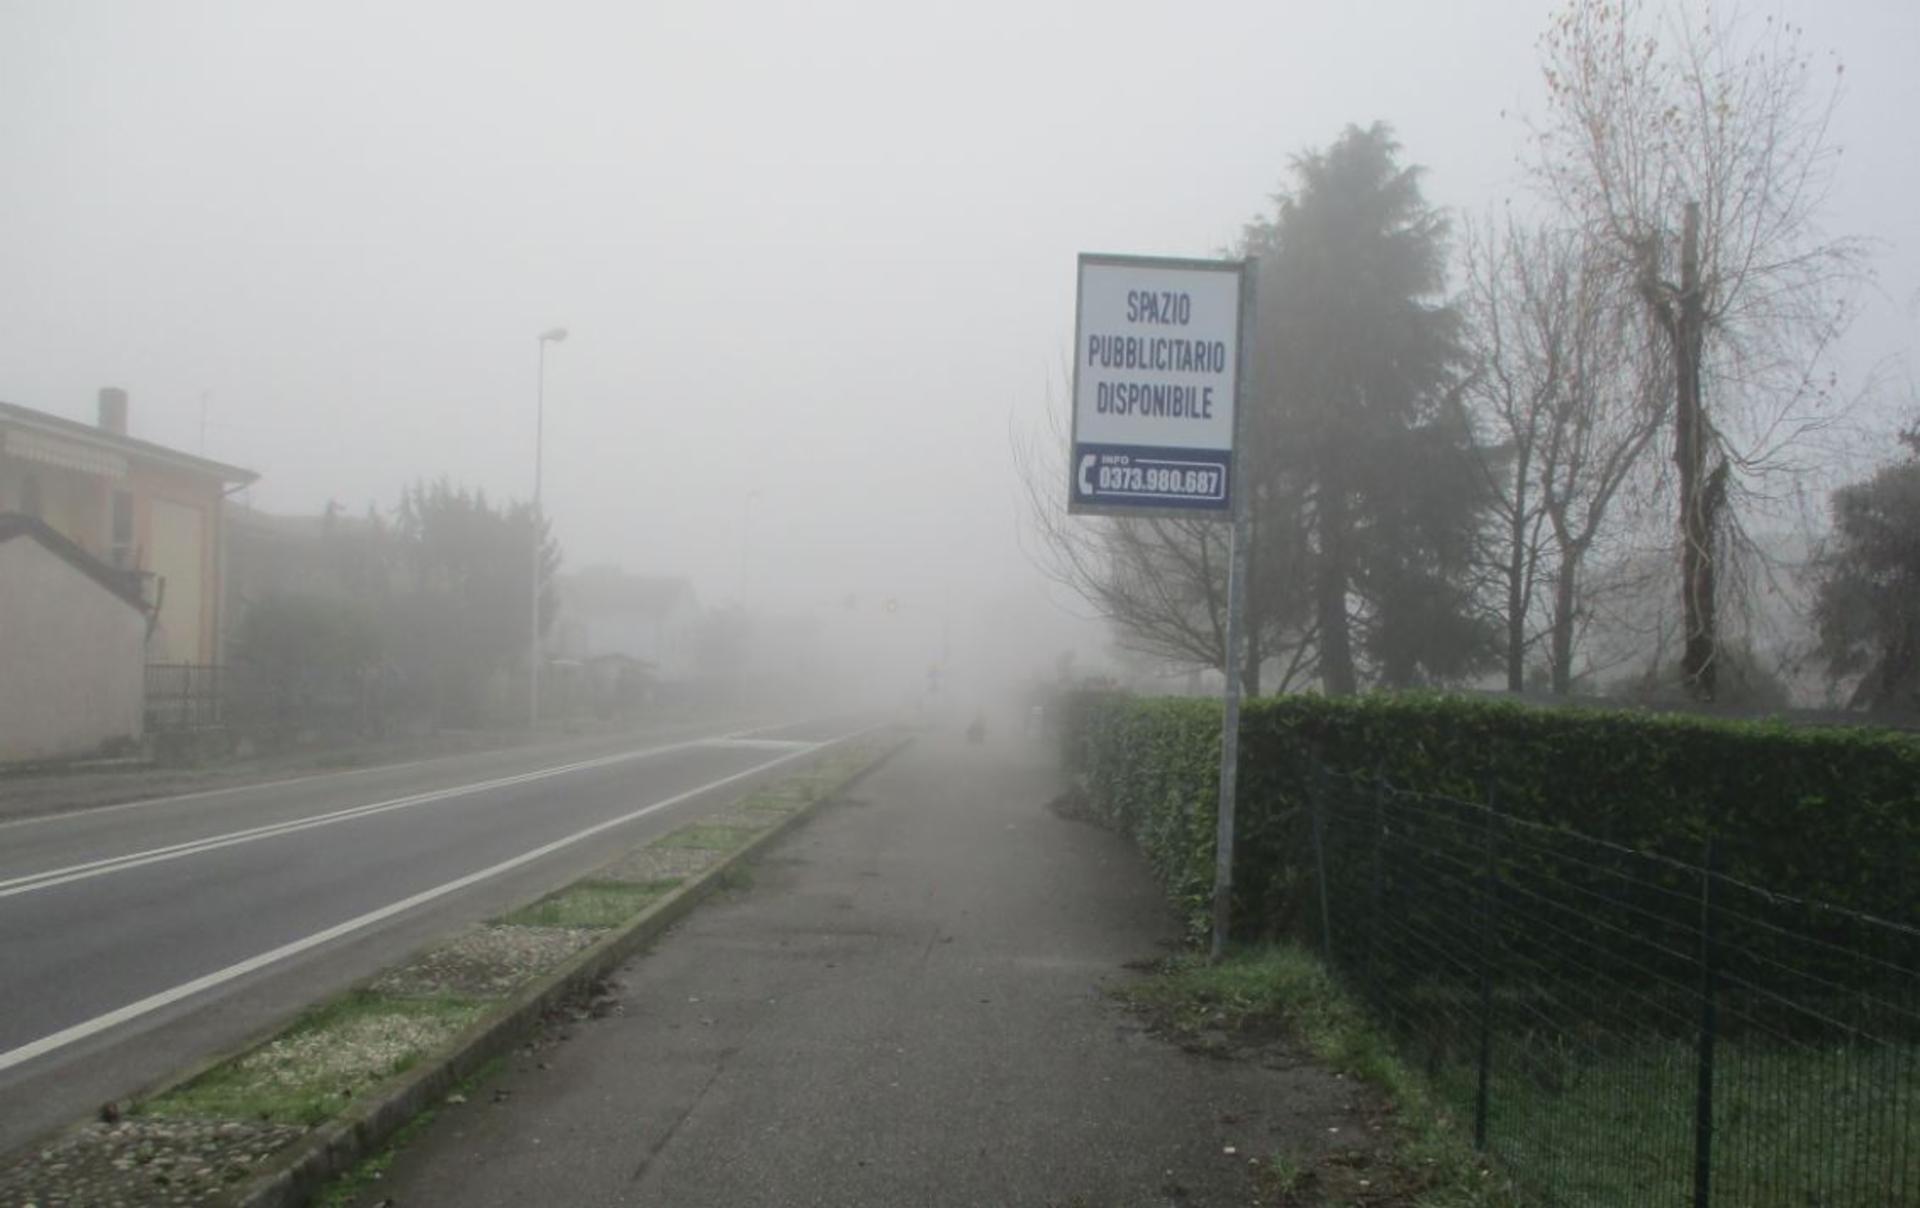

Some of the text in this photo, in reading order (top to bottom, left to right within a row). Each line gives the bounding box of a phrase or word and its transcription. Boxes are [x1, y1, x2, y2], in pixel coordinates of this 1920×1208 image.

[1127, 290, 1191, 325] SPAZIO
[1088, 334, 1226, 373] PUBBLICITARIO
[1097, 382, 1213, 419] DISPONIBILE
[1102, 455, 1129, 465] INFO
[1099, 467, 1218, 494] 0373.980.687
